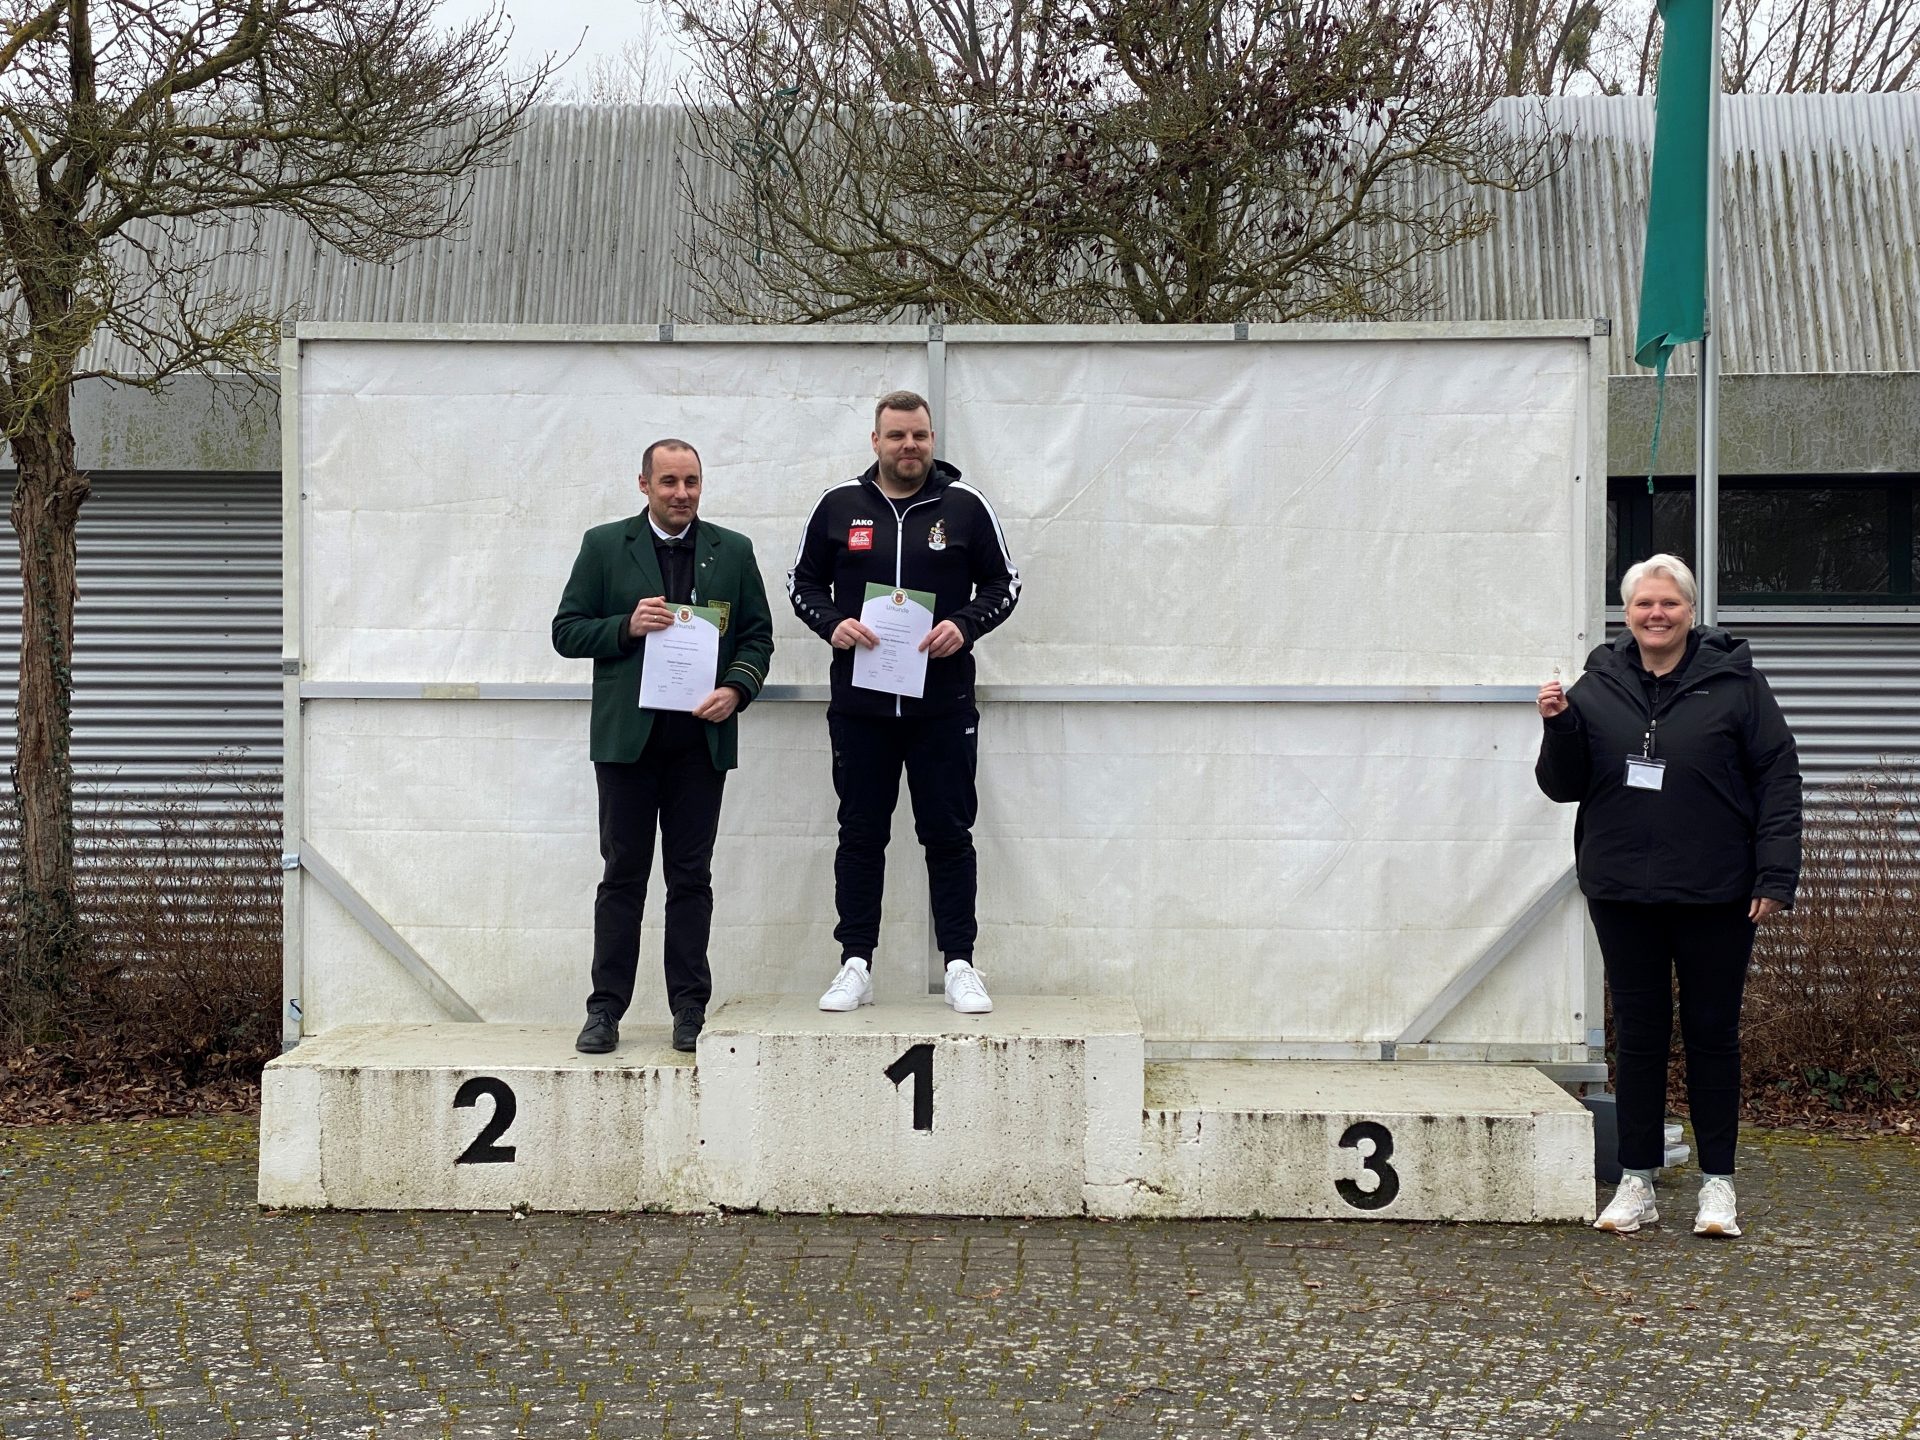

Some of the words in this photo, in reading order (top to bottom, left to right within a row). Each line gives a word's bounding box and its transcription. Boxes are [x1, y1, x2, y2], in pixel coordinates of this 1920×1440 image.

[453, 1076, 517, 1164] 2
[884, 1043, 936, 1131] 1
[1334, 1121, 1400, 1210] 3
